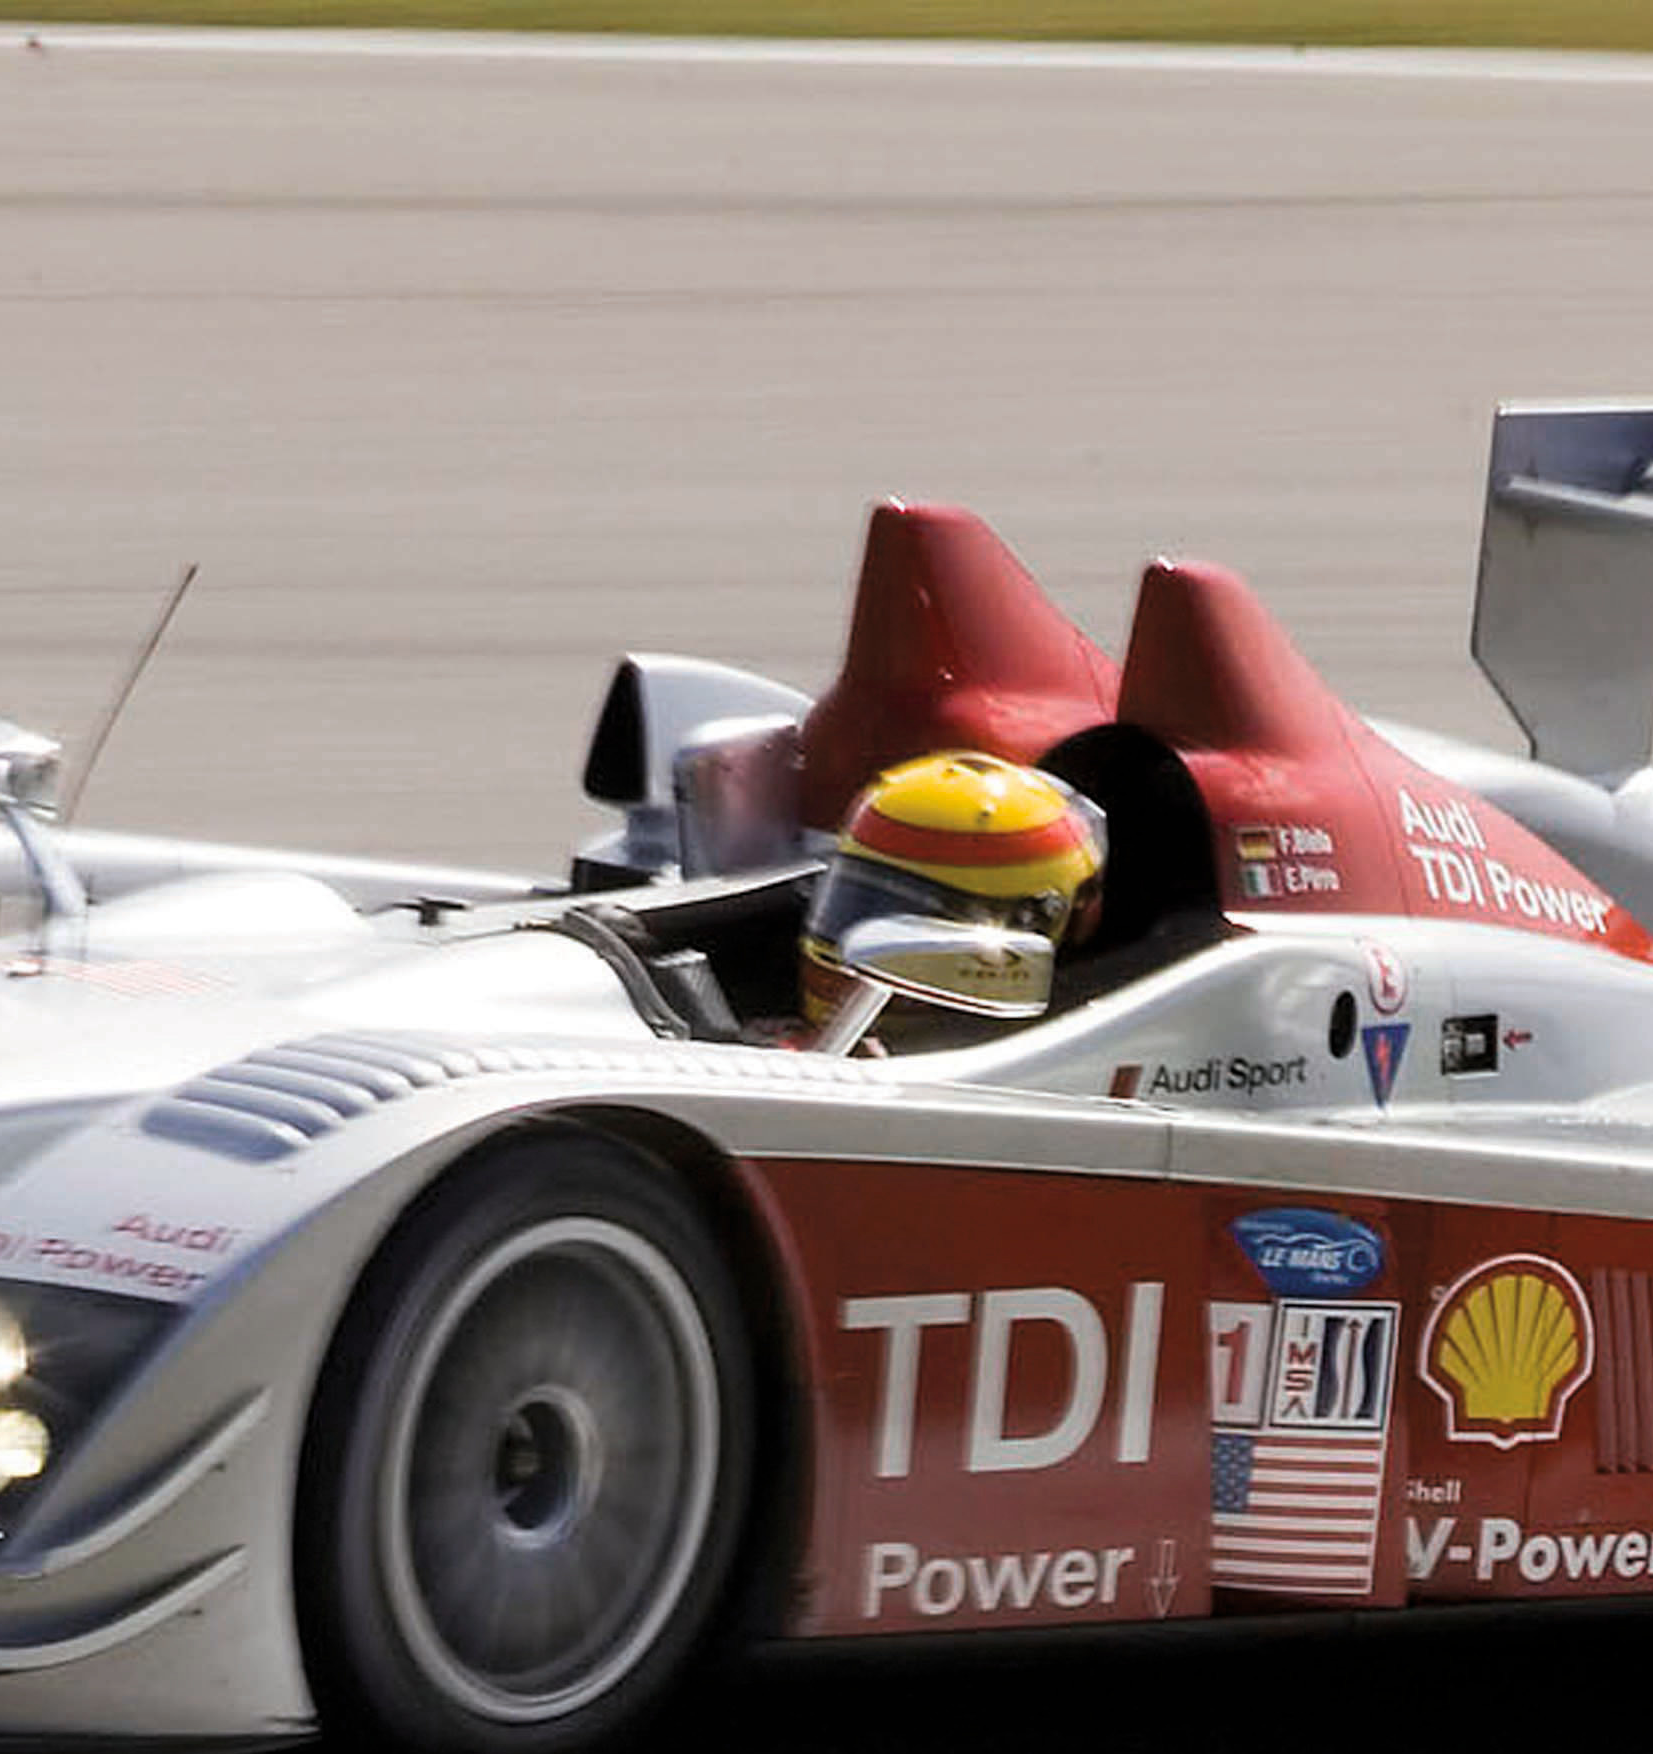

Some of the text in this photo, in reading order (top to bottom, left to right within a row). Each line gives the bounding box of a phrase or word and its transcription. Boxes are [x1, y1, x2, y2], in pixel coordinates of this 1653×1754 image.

[1399, 787, 1487, 851] Audi
[1408, 843, 1615, 934] TDI Power
[1148, 1056, 1306, 1097] Audi Sport
[112, 1214, 232, 1252] Audi
[838, 1281, 1166, 1479] TDI
[1217, 1320, 1252, 1405] 1
[861, 1542, 1137, 1619] Power
